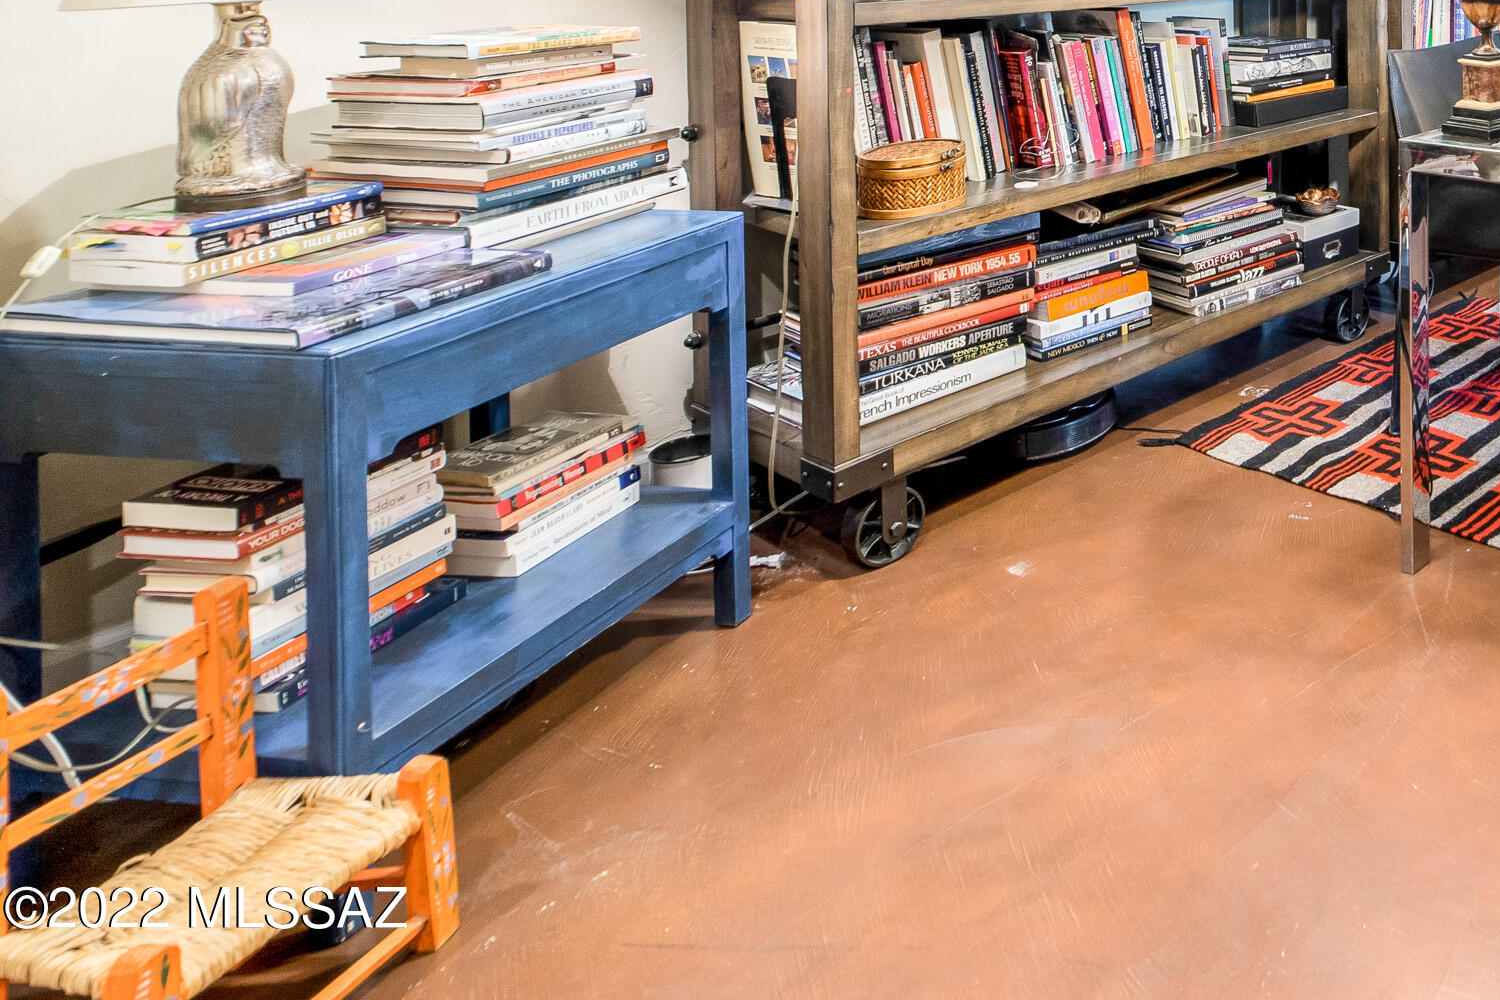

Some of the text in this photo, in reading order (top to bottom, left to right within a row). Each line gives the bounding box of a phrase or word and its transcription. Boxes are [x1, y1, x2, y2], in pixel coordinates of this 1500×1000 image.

[502, 82, 622, 109] THE AMERICAN CENTURY
[920, 72, 935, 132] Visual Culture
[512, 128, 546, 144] ARRIVALS
[552, 120, 594, 138] DEPARTURES
[549, 160, 639, 189] THE PHOTOGRAPHS
[525, 185, 648, 229] EARTH FROM ABOVE
[1137, 231, 1153, 240] WORLD
[188, 226, 367, 280] SILENCES TILLIE OLSEN
[883, 256, 934, 275] One Digital Day
[332, 264, 372, 282] GONE
[857, 252, 1020, 299] WILLIAM KLEIN NEW YORK 1954.55
[1237, 266, 1264, 283] Jazz
[986, 283, 1014, 295] SALGADO
[1064, 282, 1128, 311] magnum
[866, 303, 913, 320] MIGRATIONS
[859, 318, 980, 361] TEXAS THE BEAUTIFUL COOKBOOK
[869, 323, 1014, 372] SALGADO WORKERS APERTURE
[1048, 347, 1062, 358] NEW
[1062, 341, 1085, 353] MEXICO
[1087, 336, 1099, 344] THEN
[1106, 330, 1118, 338] NOW
[962, 352, 978, 361] THE
[872, 357, 946, 390] TURKANA
[860, 371, 972, 419] rench Impressionism
[248, 518, 304, 548] YOUR DOG
